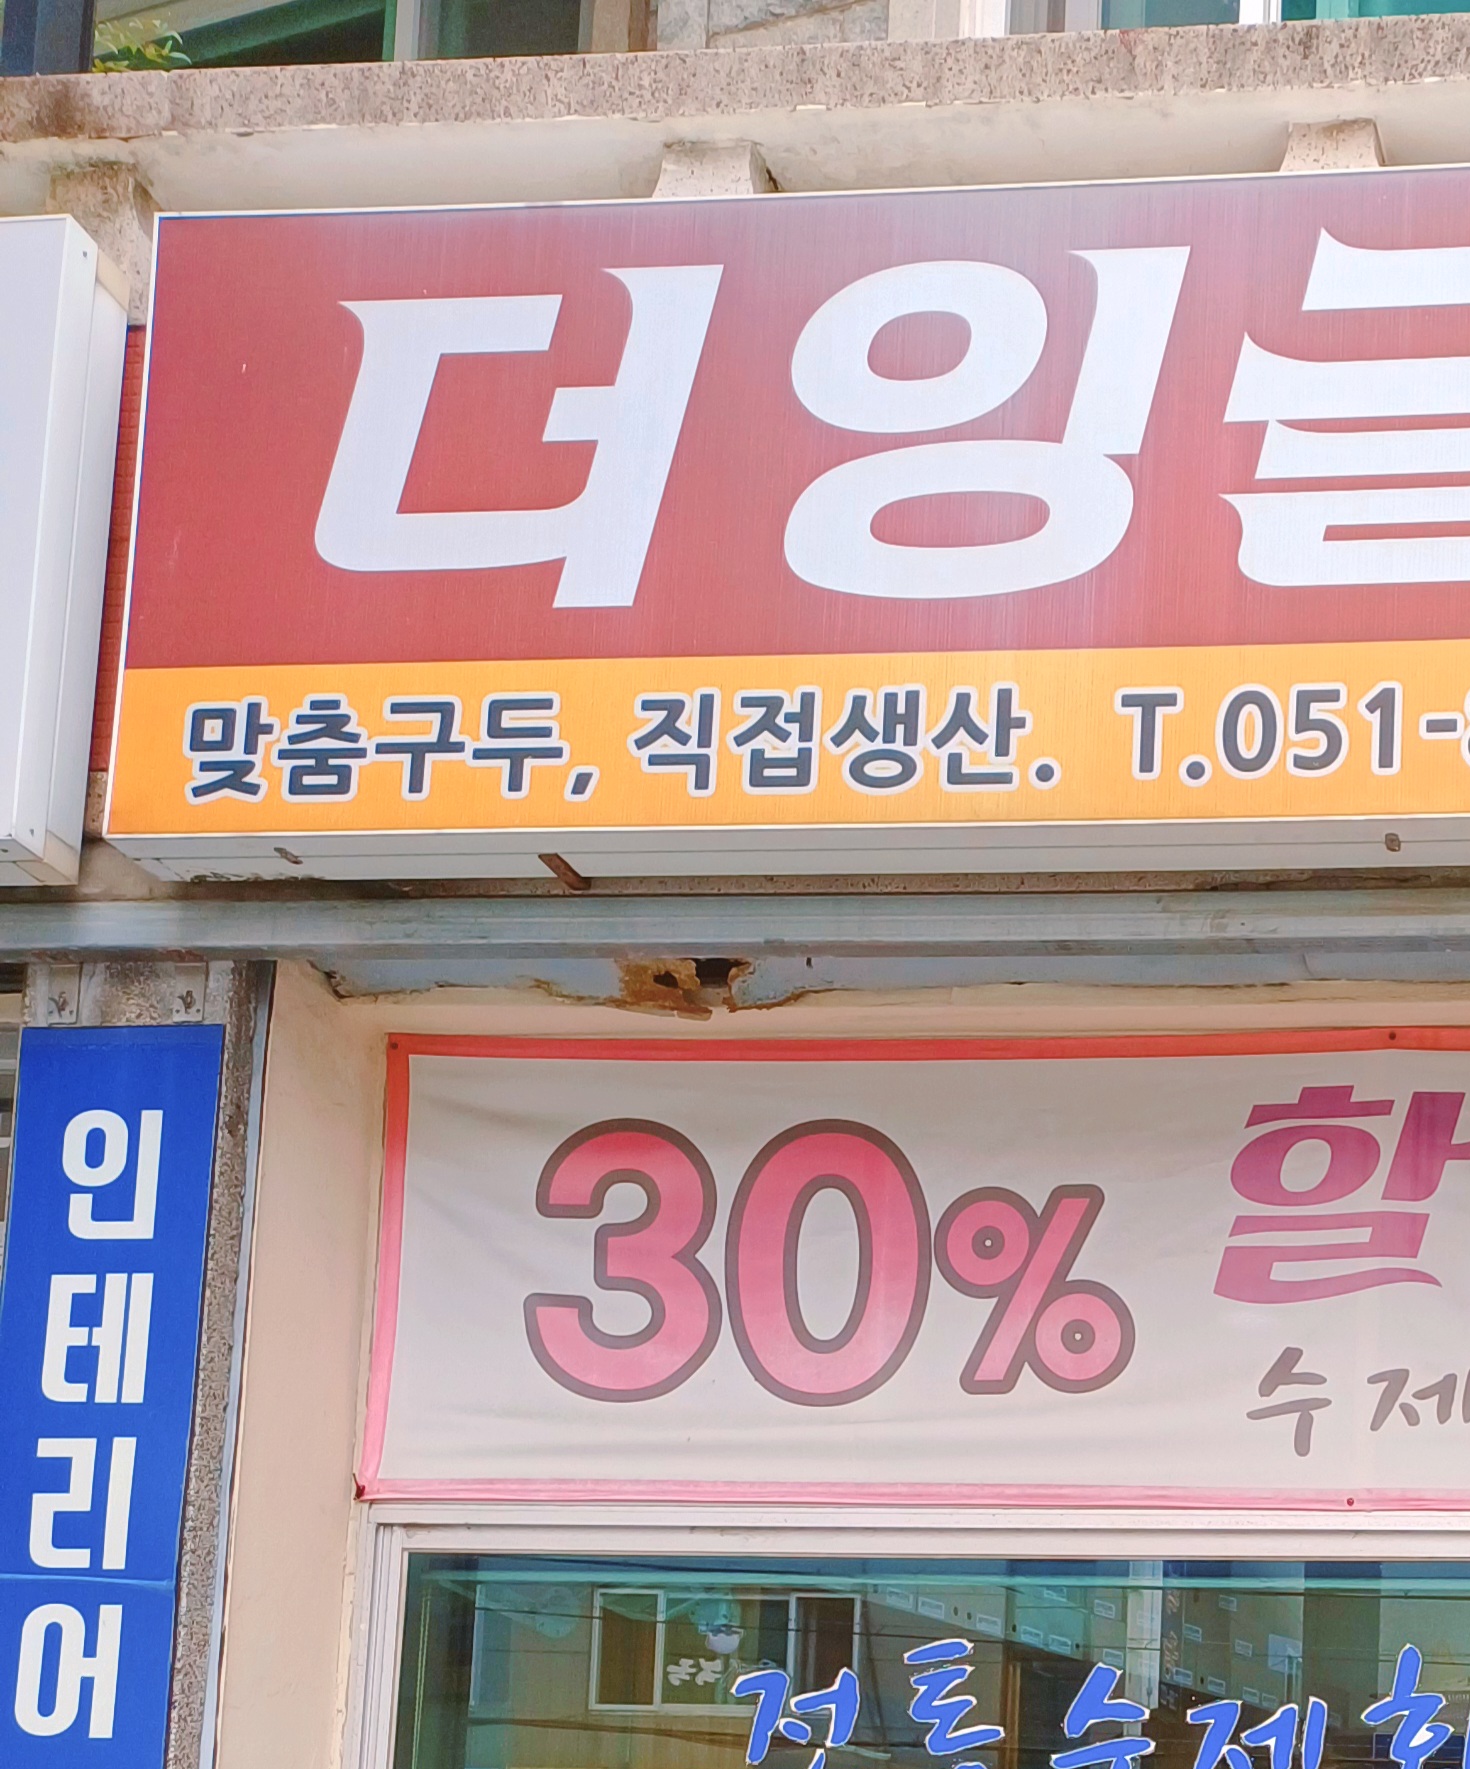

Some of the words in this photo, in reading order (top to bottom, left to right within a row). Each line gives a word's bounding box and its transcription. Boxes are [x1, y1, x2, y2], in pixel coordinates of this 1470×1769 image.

[187, 692, 599, 801] 맞춤구두,
[630, 684, 1061, 796] 직접생산.
[524, 1118, 1136, 1406] 30%
[14, 1109, 163, 1739] 인테리어
